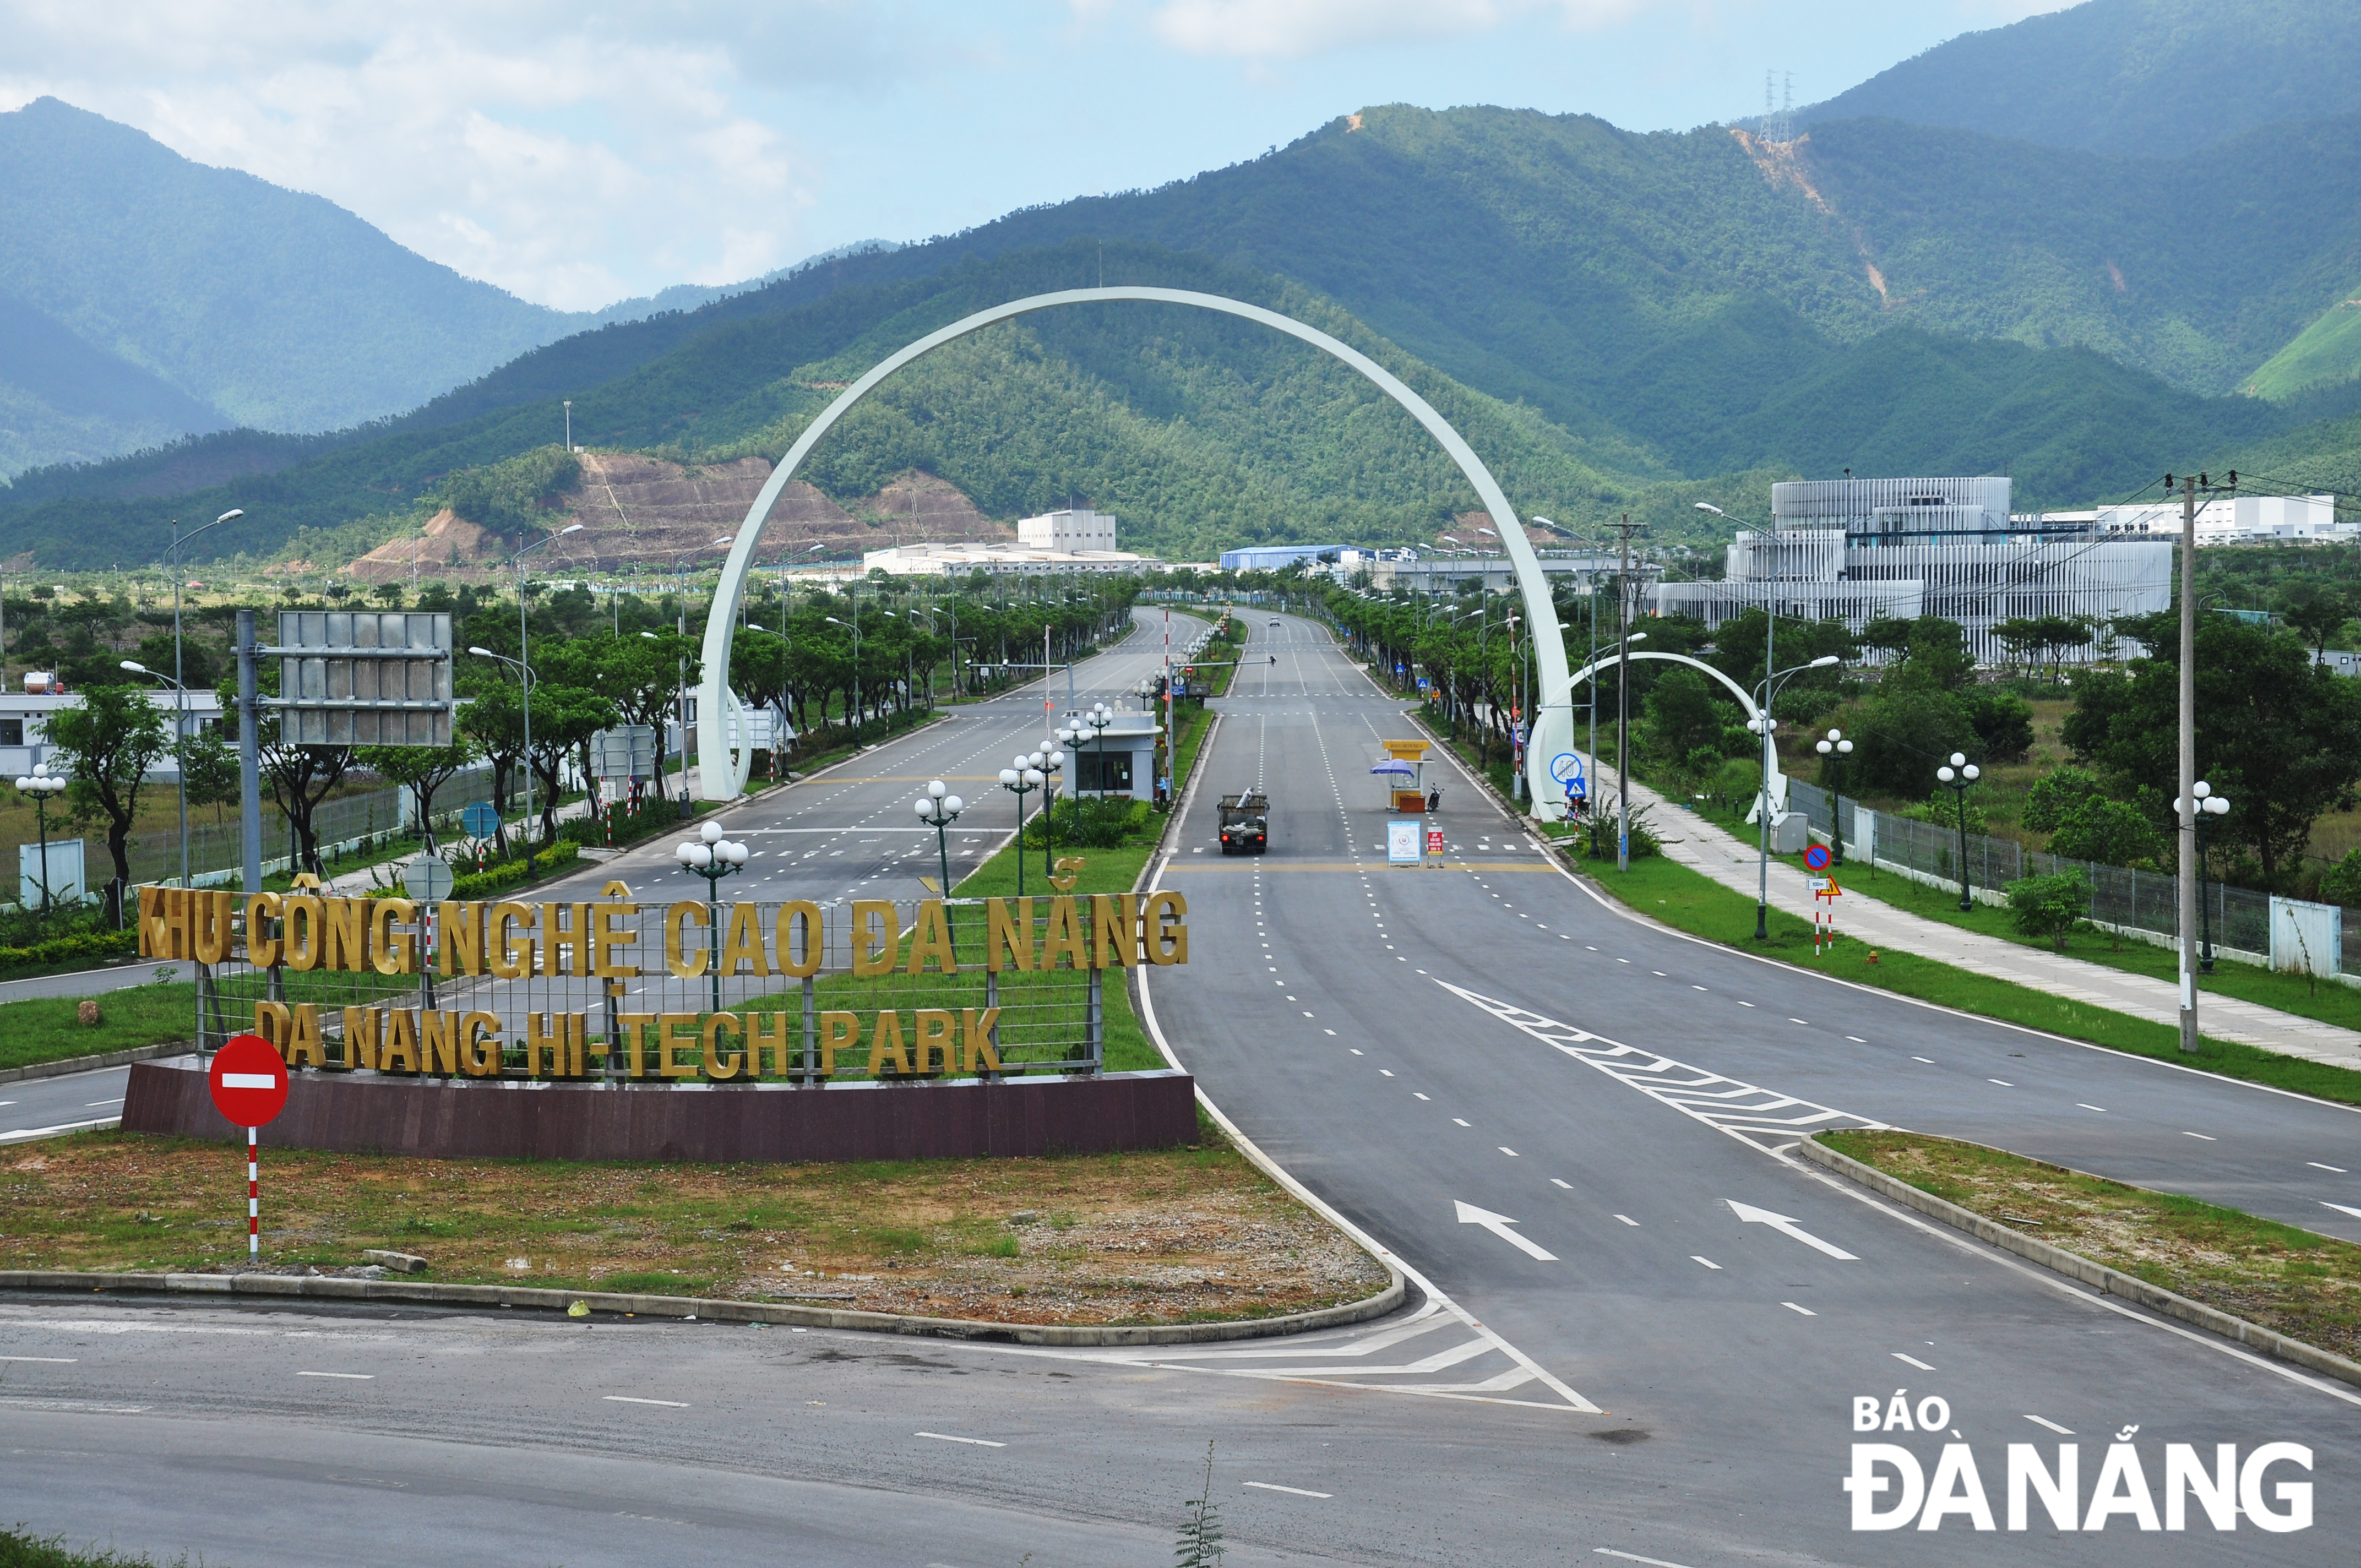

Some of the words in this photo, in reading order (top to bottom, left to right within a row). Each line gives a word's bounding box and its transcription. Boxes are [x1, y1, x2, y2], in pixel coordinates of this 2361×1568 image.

[1557, 760, 1574, 777] 40
[139, 886, 232, 965] KHU
[247, 873, 417, 974] CÔNG
[440, 880, 639, 997] NGHỆ
[666, 900, 823, 979] CAO
[850, 876, 957, 975] ĐÀ
[987, 857, 1188, 971] NẴNG
[254, 1001, 326, 1066] DA
[344, 1005, 503, 1076] NANG
[528, 1012, 787, 1079] HI-TECH
[820, 1007, 1002, 1075] PARK
